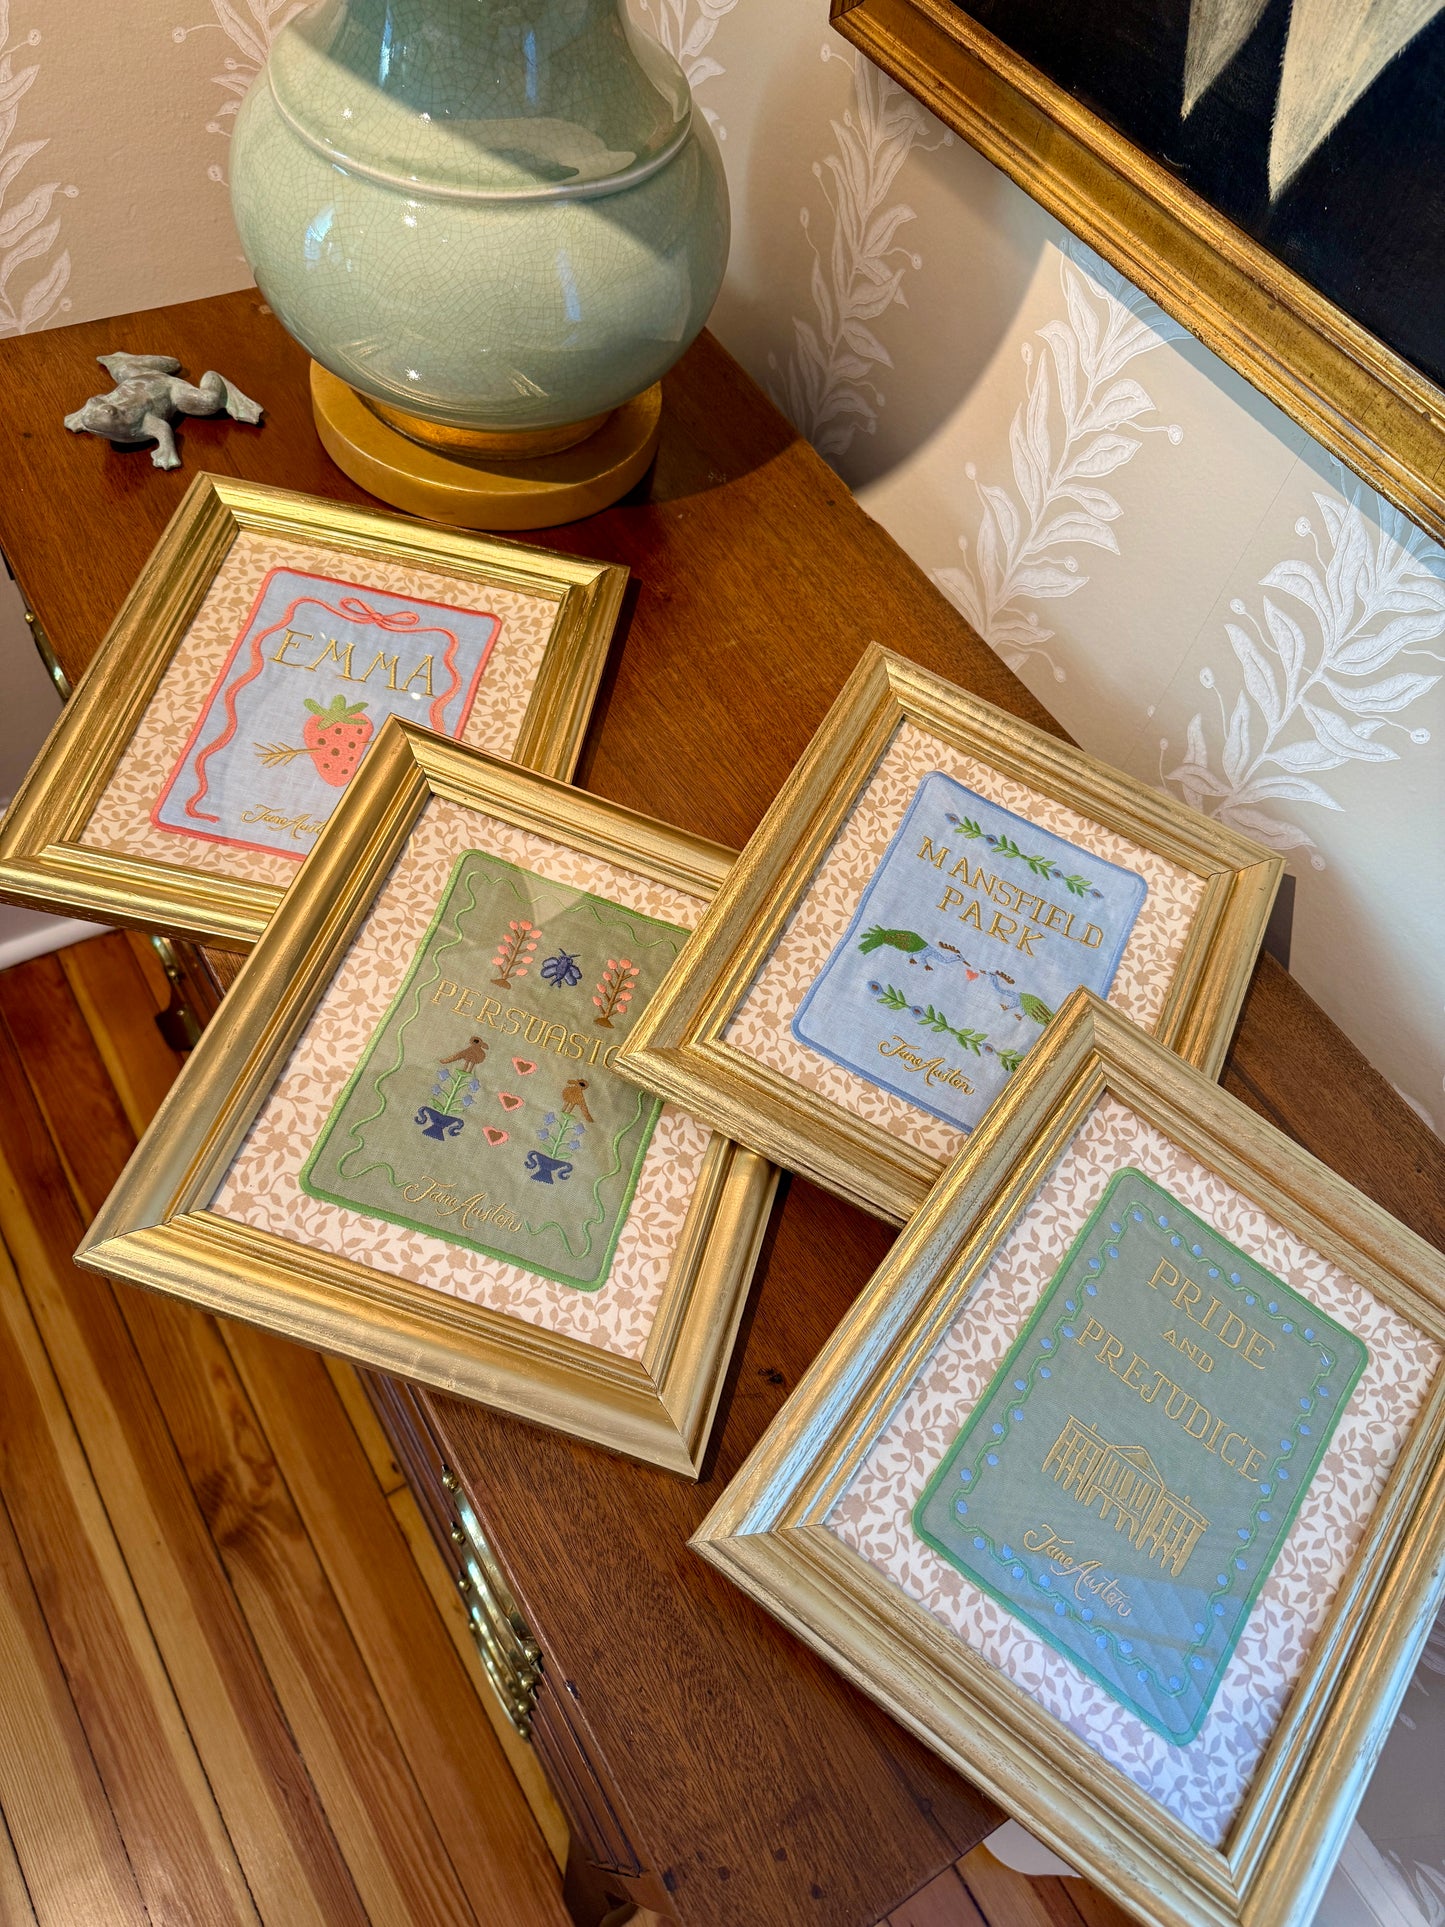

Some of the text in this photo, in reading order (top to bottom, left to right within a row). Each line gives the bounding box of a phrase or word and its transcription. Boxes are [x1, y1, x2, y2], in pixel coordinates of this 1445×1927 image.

[268, 628, 437, 698] EMMA
[241, 803, 328, 840] Jane Aust
[916, 835, 1104, 949] MANSFIELD
[936, 884, 1046, 958] PARK
[430, 978, 622, 1069] PERSUASIO
[878, 1034, 976, 1096] Jane Austen
[403, 1175, 523, 1232] Jane Austen
[1146, 1256, 1277, 1370] PRIDE
[1160, 1328, 1215, 1374] AND
[1075, 1315, 1268, 1483] PREJUDICE
[1023, 1523, 1132, 1617] Jane Austen
